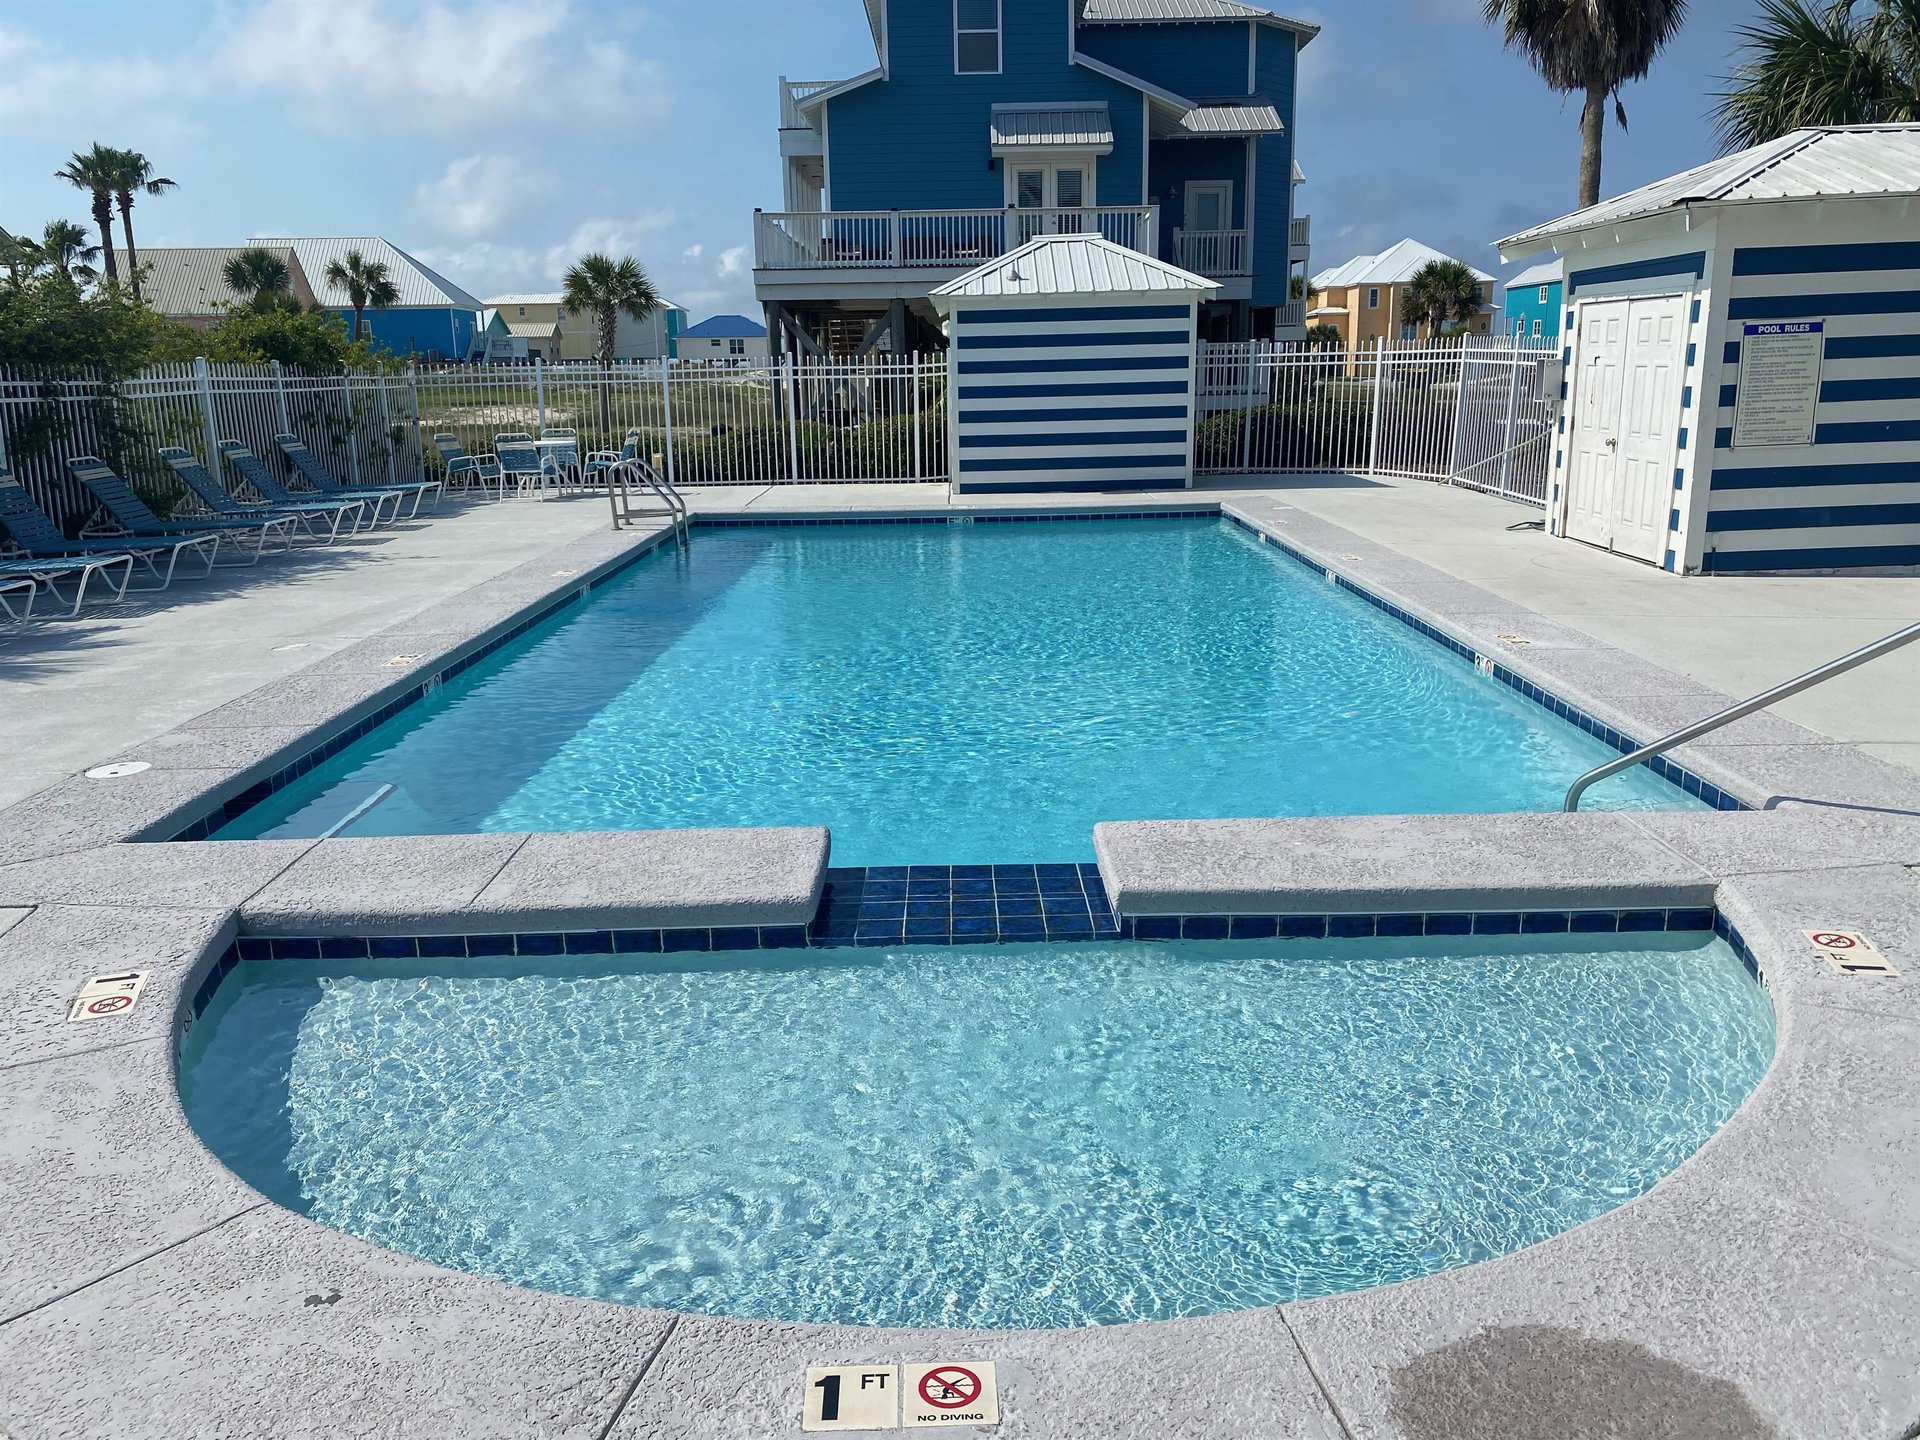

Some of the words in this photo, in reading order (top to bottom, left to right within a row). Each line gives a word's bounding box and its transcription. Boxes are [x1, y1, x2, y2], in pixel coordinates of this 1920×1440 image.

[1758, 325, 1781, 334] POOL
[1784, 324, 1810, 332] RULES
[95, 973, 140, 983] 1
[814, 1374, 841, 1421] 1
[860, 1373, 890, 1390] FT
[940, 1413, 984, 1421] DIVING
